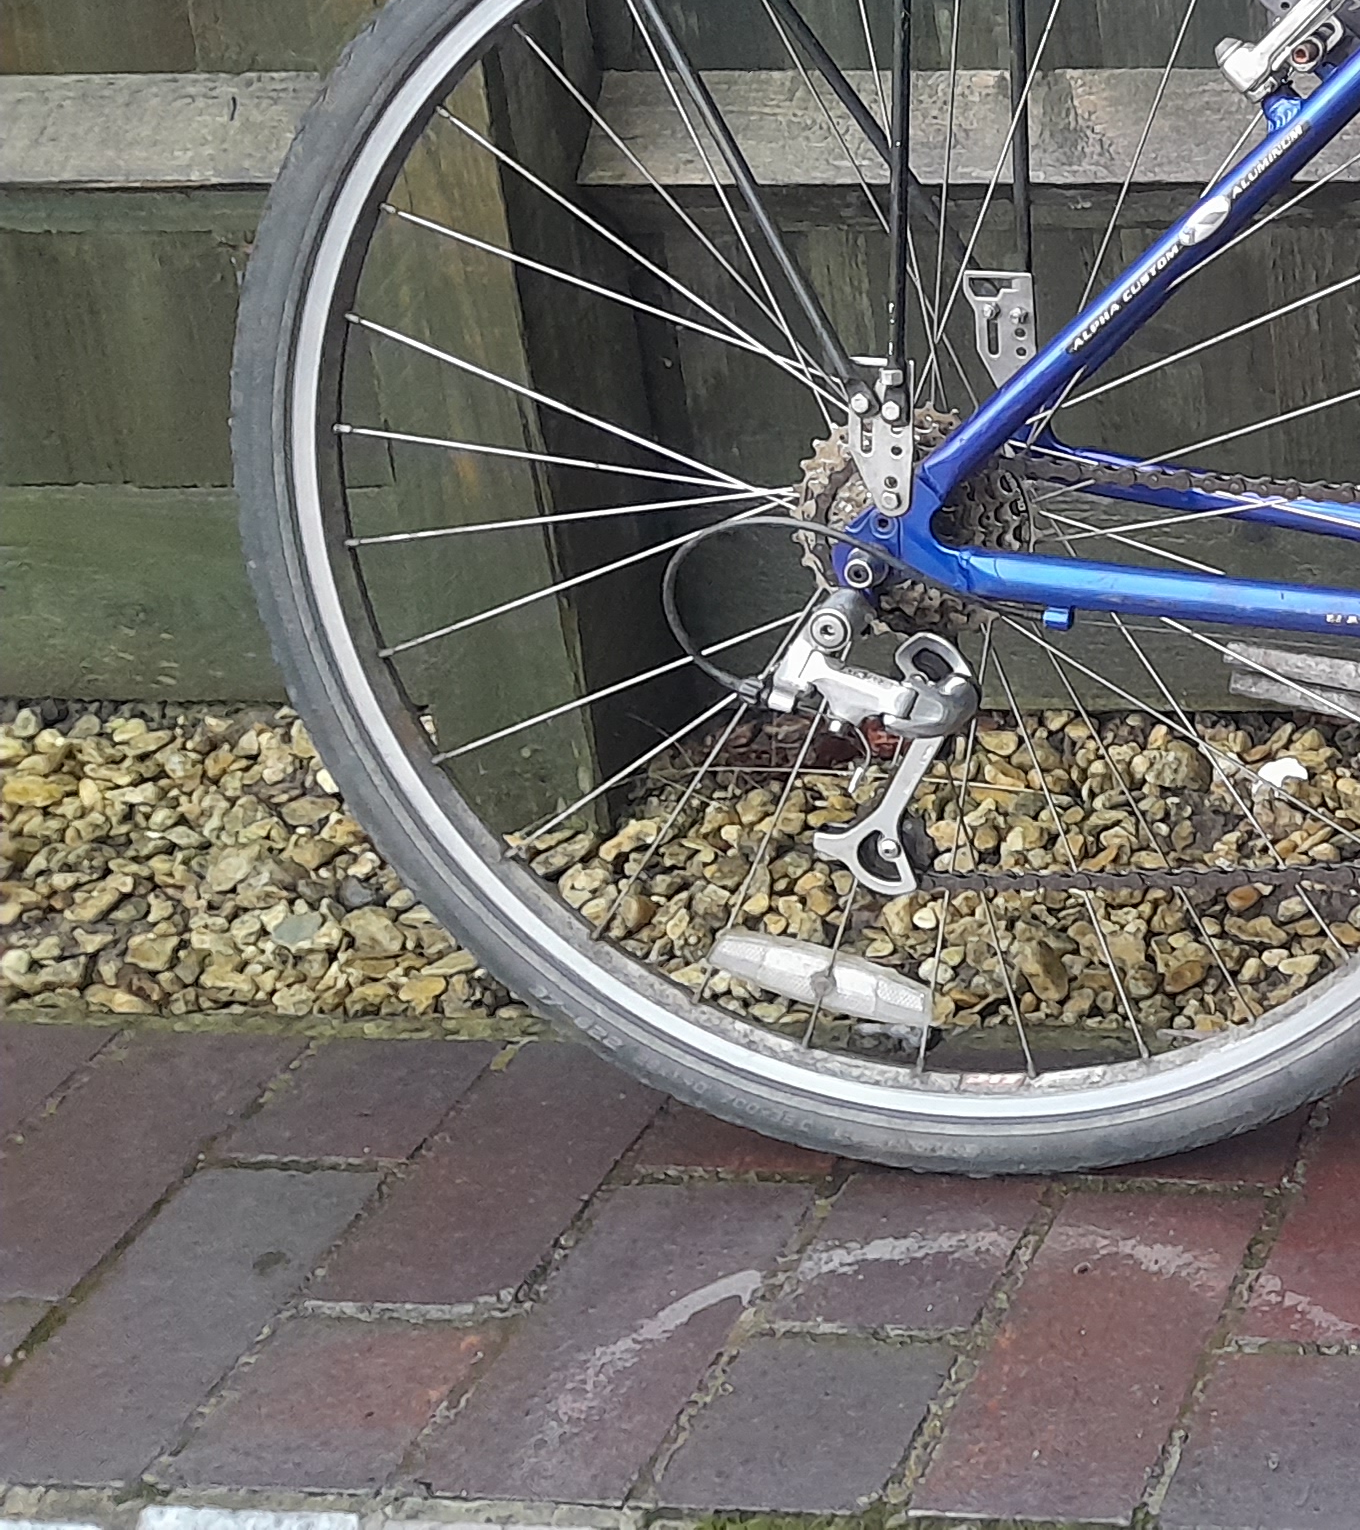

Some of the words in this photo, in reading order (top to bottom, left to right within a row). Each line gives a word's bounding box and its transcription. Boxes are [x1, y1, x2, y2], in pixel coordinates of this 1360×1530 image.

[1071, 301, 1121, 351] ALPHA
[1121, 245, 1180, 302] CUSTOM
[1231, 125, 1304, 199] ALUMINUM
